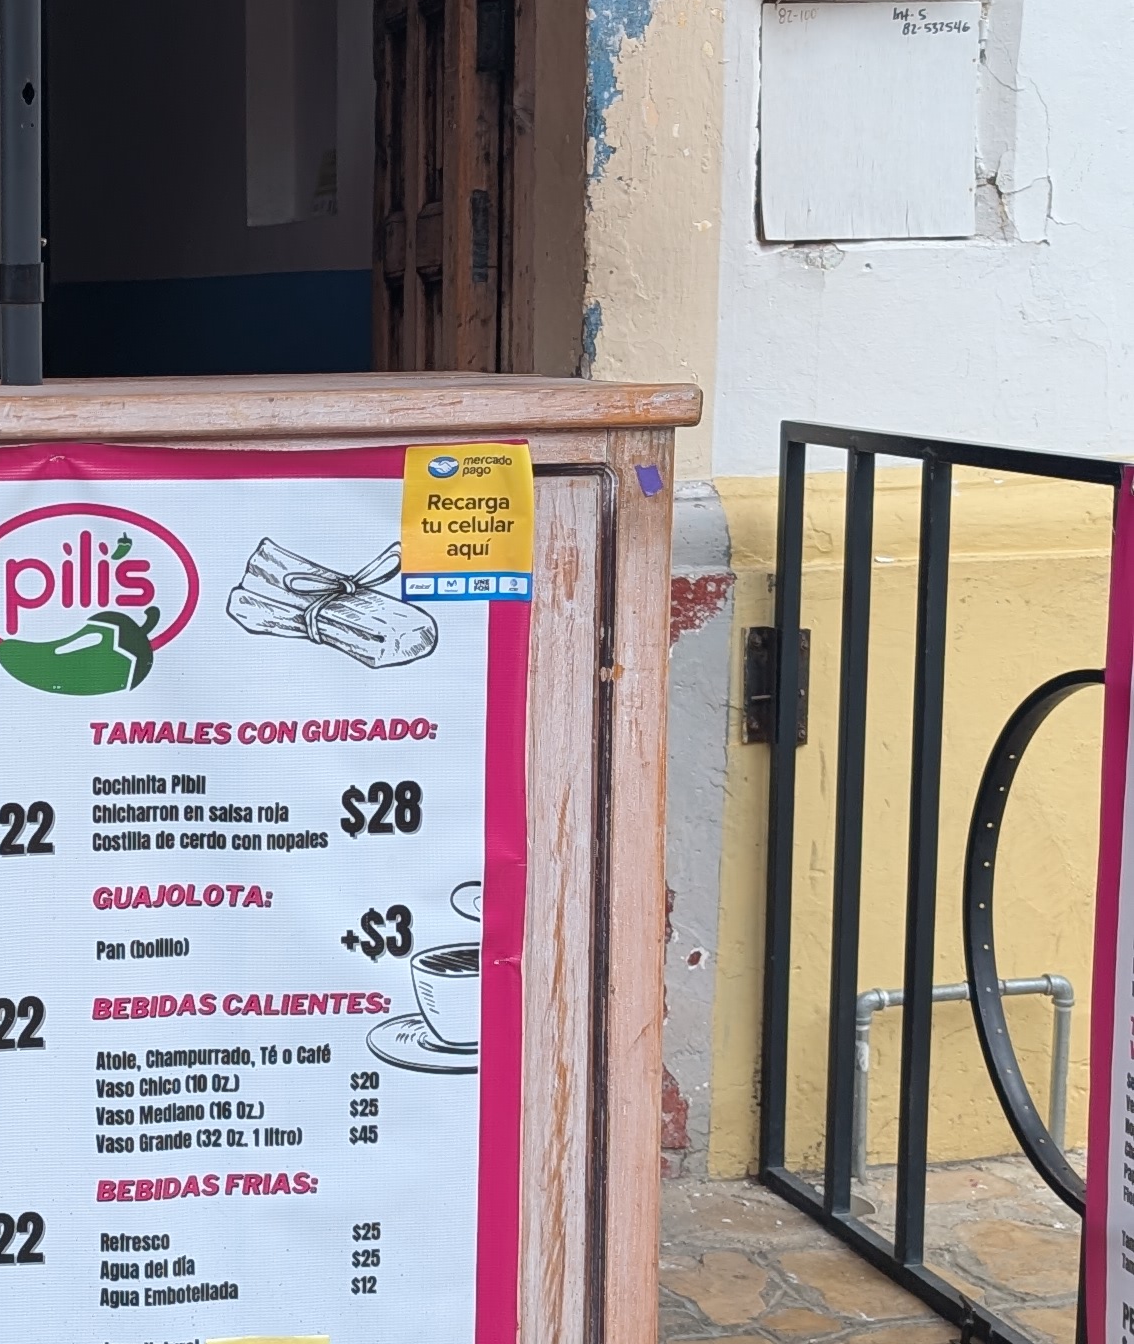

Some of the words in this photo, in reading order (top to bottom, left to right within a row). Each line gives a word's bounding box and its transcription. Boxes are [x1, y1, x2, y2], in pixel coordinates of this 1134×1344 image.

[462, 455, 513, 466] mercado
[462, 466, 492, 477] pago
[427, 494, 510, 514] Recarga
[421, 517, 442, 534] tu
[447, 516, 515, 533] celular
[446, 538, 492, 561] aquí
[90, 721, 232, 745] TAMALES
[238, 721, 298, 744] CON
[302, 718, 438, 742] GUISADO:
[93, 775, 166, 795] Cochinita
[172, 774, 205, 794] Pibil
[93, 804, 178, 823] Chicharron
[184, 805, 203, 821] en
[209, 804, 252, 822] salsa
[258, 803, 288, 823] roja
[341, 781, 421, 837] $28
[93, 831, 150, 851] Costilla
[156, 831, 174, 849] de
[180, 831, 226, 849] cerdo
[232, 834, 261, 850] con
[267, 830, 328, 852] nopales
[93, 884, 273, 910] GUAJOLOTA:
[341, 905, 412, 961] +$3
[97, 941, 125, 960] Pan
[131, 938, 189, 958] (bolillo)
[92, 994, 217, 1020] BEBIDAS
[223, 992, 391, 1016] CALIENTES:
[96, 1051, 141, 1071] Atole,
[146, 1047, 255, 1068] Champurrado,
[260, 1045, 277, 1065] Té
[283, 1049, 292, 1064] o
[297, 1044, 330, 1064] Café
[96, 1080, 134, 1098] Vaso
[140, 1076, 180, 1096] Chico
[186, 1074, 207, 1093] (10
[212, 1074, 239, 1092] Oz.)
[351, 1072, 379, 1090] $20
[350, 1098, 378, 1117] $25
[96, 1135, 134, 1153] Vaso
[140, 1131, 191, 1152] Grande
[197, 1129, 221, 1147] (32
[227, 1129, 247, 1147] Oz.
[253, 1129, 259, 1146] 1
[265, 1128, 302, 1146] litro)
[350, 1125, 378, 1144] $45
[97, 1174, 220, 1202] BEBIDAS
[225, 1172, 318, 1195] FRIAS:
[101, 1233, 169, 1252] Refresco
[353, 1222, 380, 1241] $25
[101, 1261, 139, 1281] Agua
[145, 1259, 168, 1278] del
[173, 1256, 194, 1276] día
[352, 1249, 380, 1268] $25
[100, 1288, 139, 1308] Agua
[145, 1282, 238, 1306] Embotellada
[351, 1276, 376, 1294] $12
